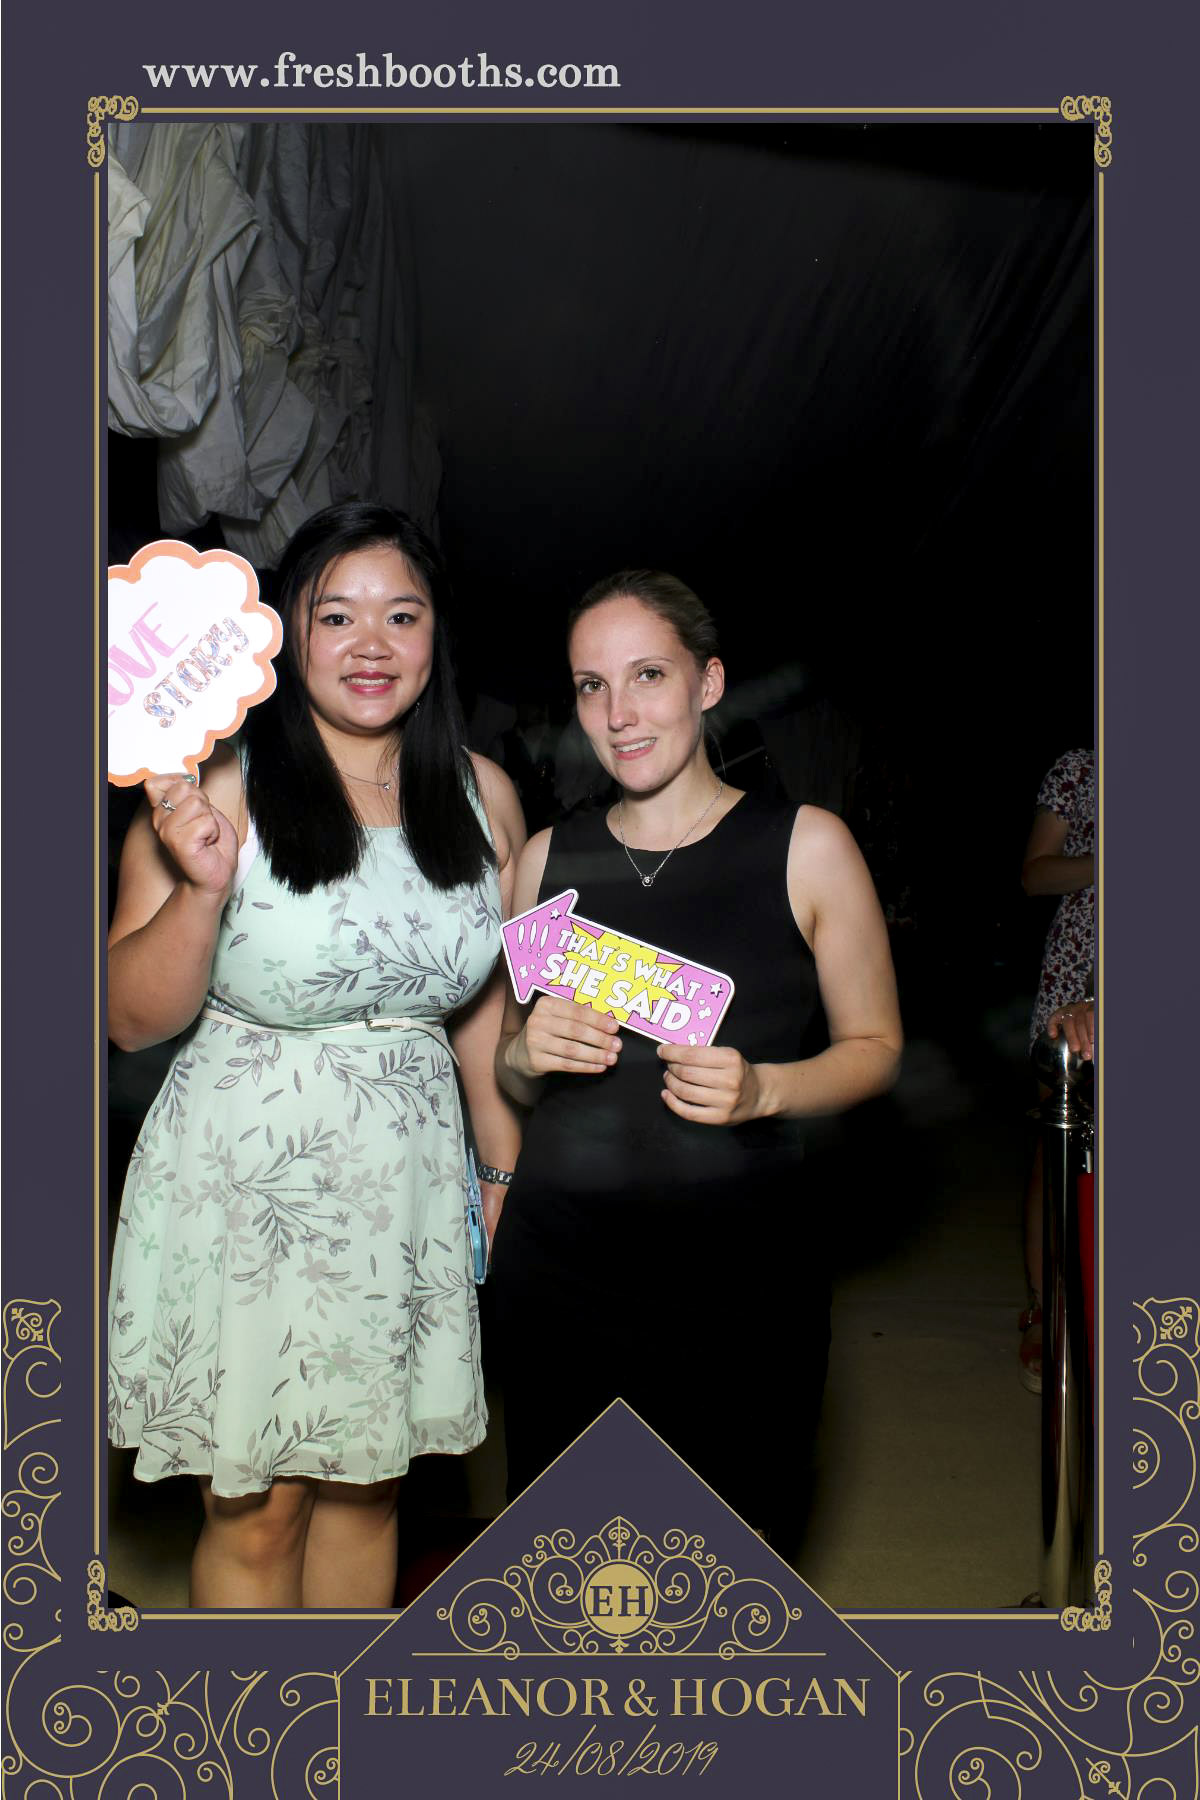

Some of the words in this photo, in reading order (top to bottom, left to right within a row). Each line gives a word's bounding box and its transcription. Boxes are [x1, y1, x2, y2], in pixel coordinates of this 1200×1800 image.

[107, 601, 190, 719] OVE
[143, 616, 250, 729] STORY
[538, 951, 608, 998] SHE
[603, 980, 692, 1032] SAID
[556, 929, 631, 973] THAT'S
[633, 959, 703, 1001] WHAT
